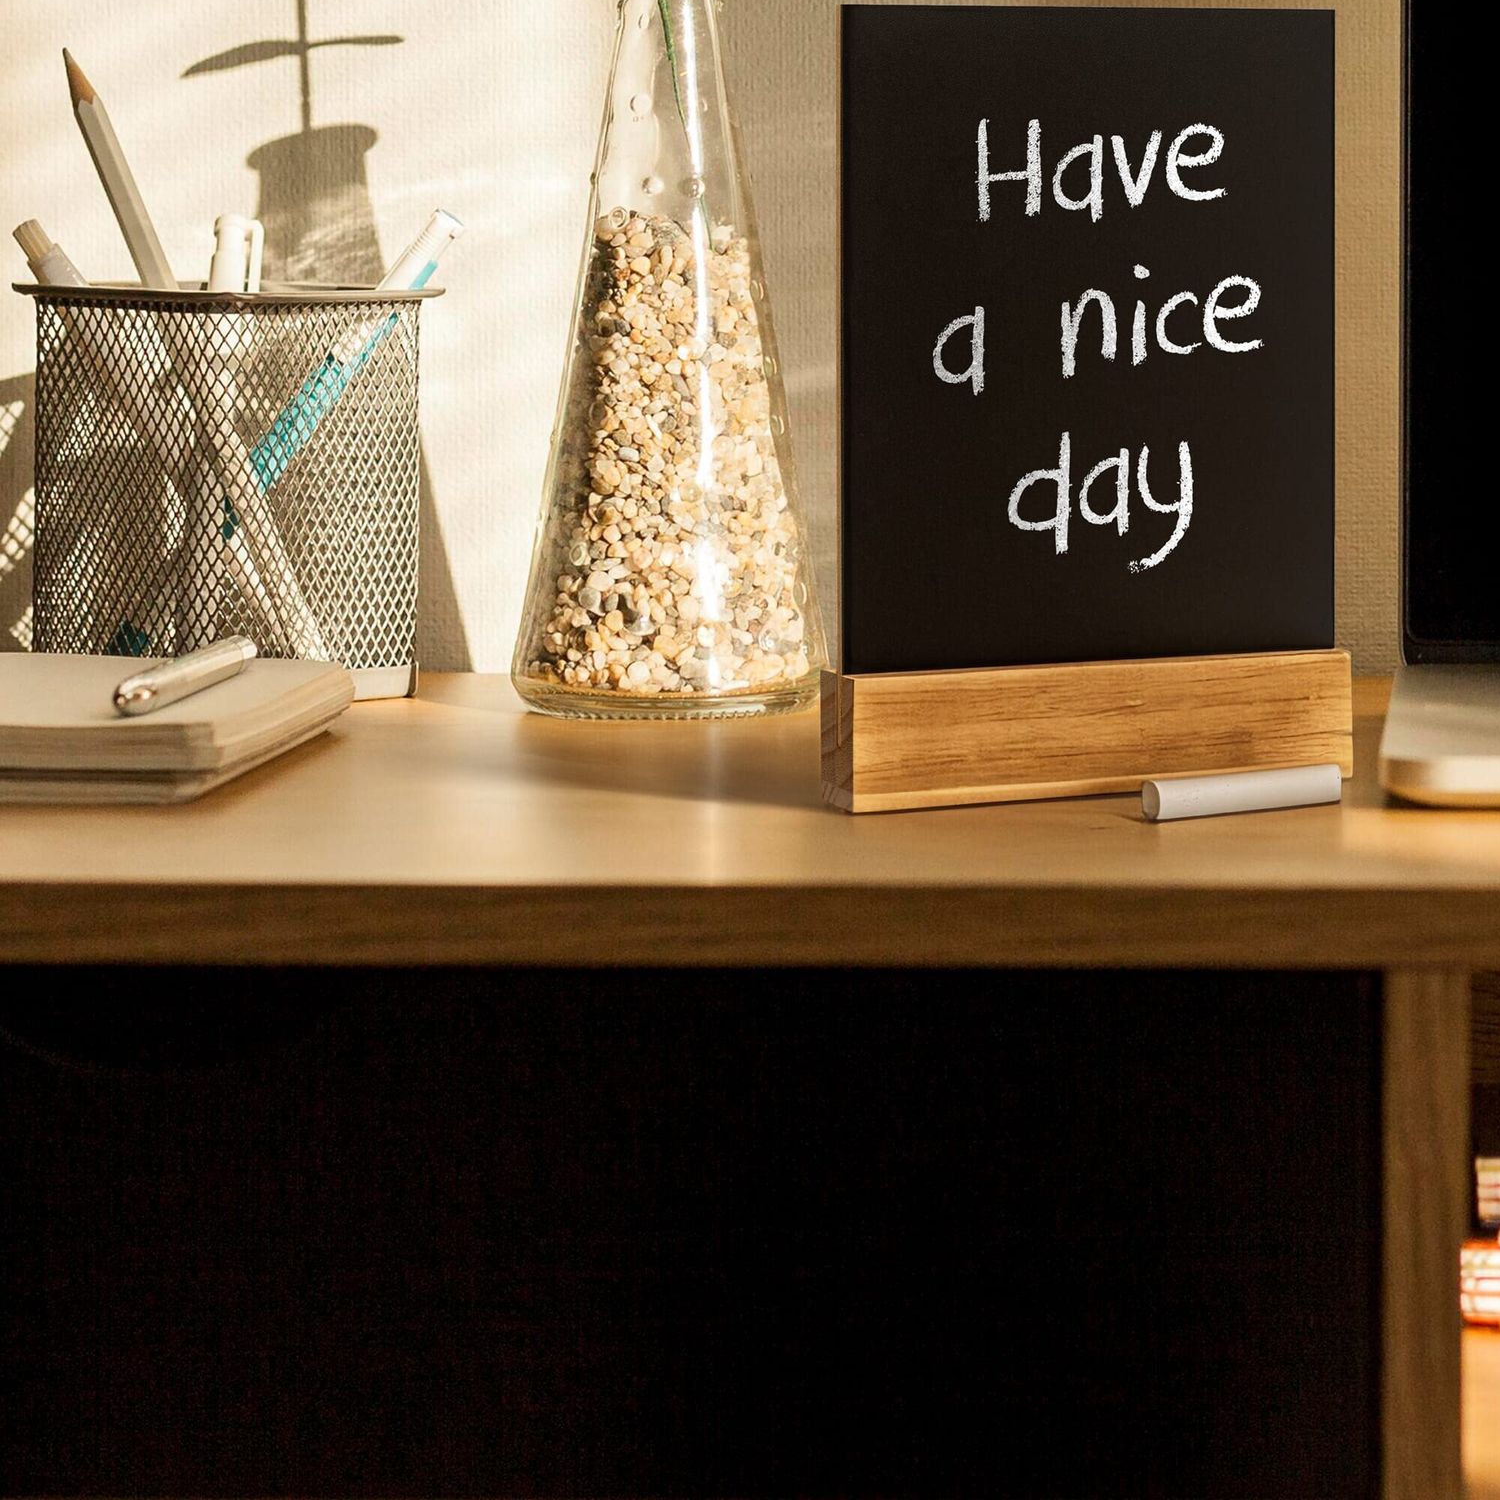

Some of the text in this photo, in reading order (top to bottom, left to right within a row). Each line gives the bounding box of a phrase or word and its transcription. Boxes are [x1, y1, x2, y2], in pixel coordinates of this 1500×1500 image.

[974, 118, 1229, 223] Have
[932, 263, 1265, 396] a nice
[1007, 431, 1195, 574] day
